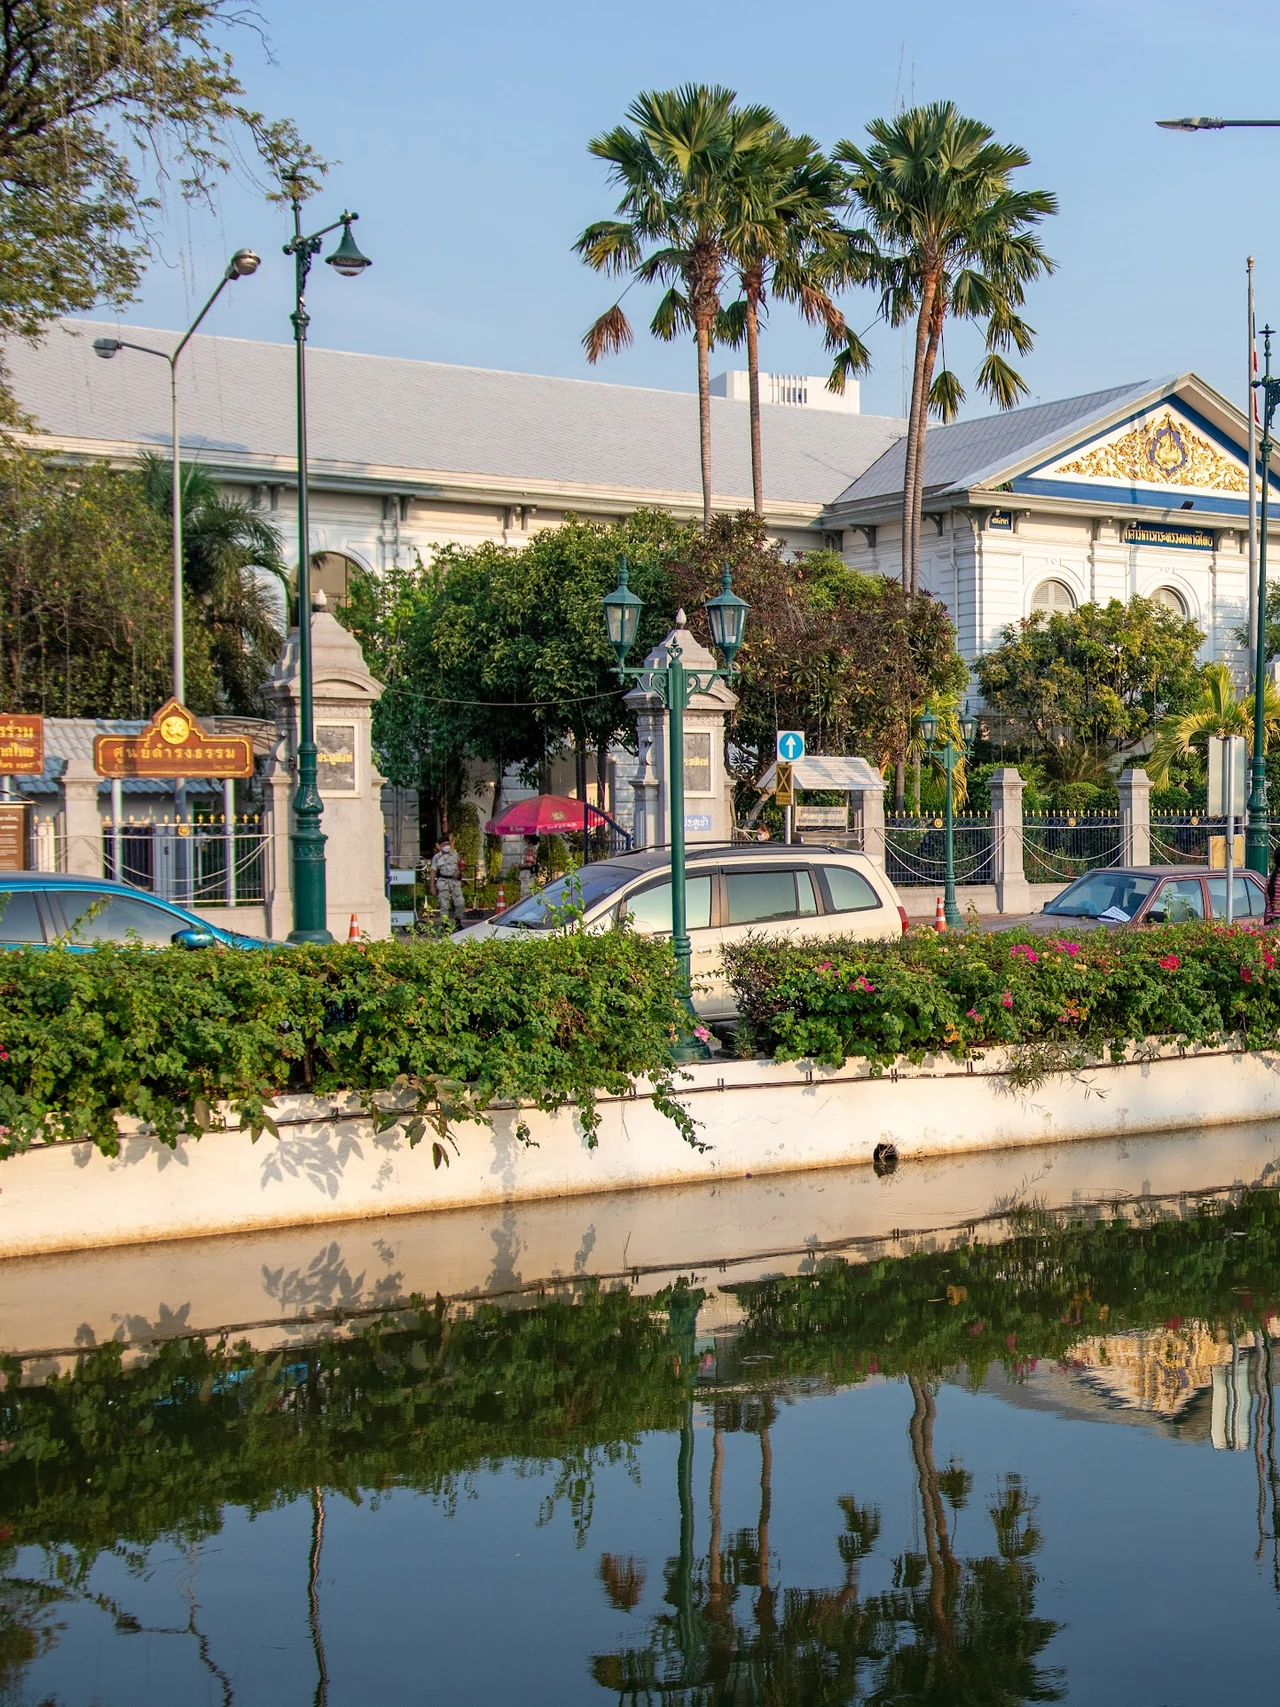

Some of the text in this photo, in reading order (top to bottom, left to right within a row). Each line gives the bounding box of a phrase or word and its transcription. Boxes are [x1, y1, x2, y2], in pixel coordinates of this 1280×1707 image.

[113, 741, 235, 763] ศูนย์ดำรงธรรม
